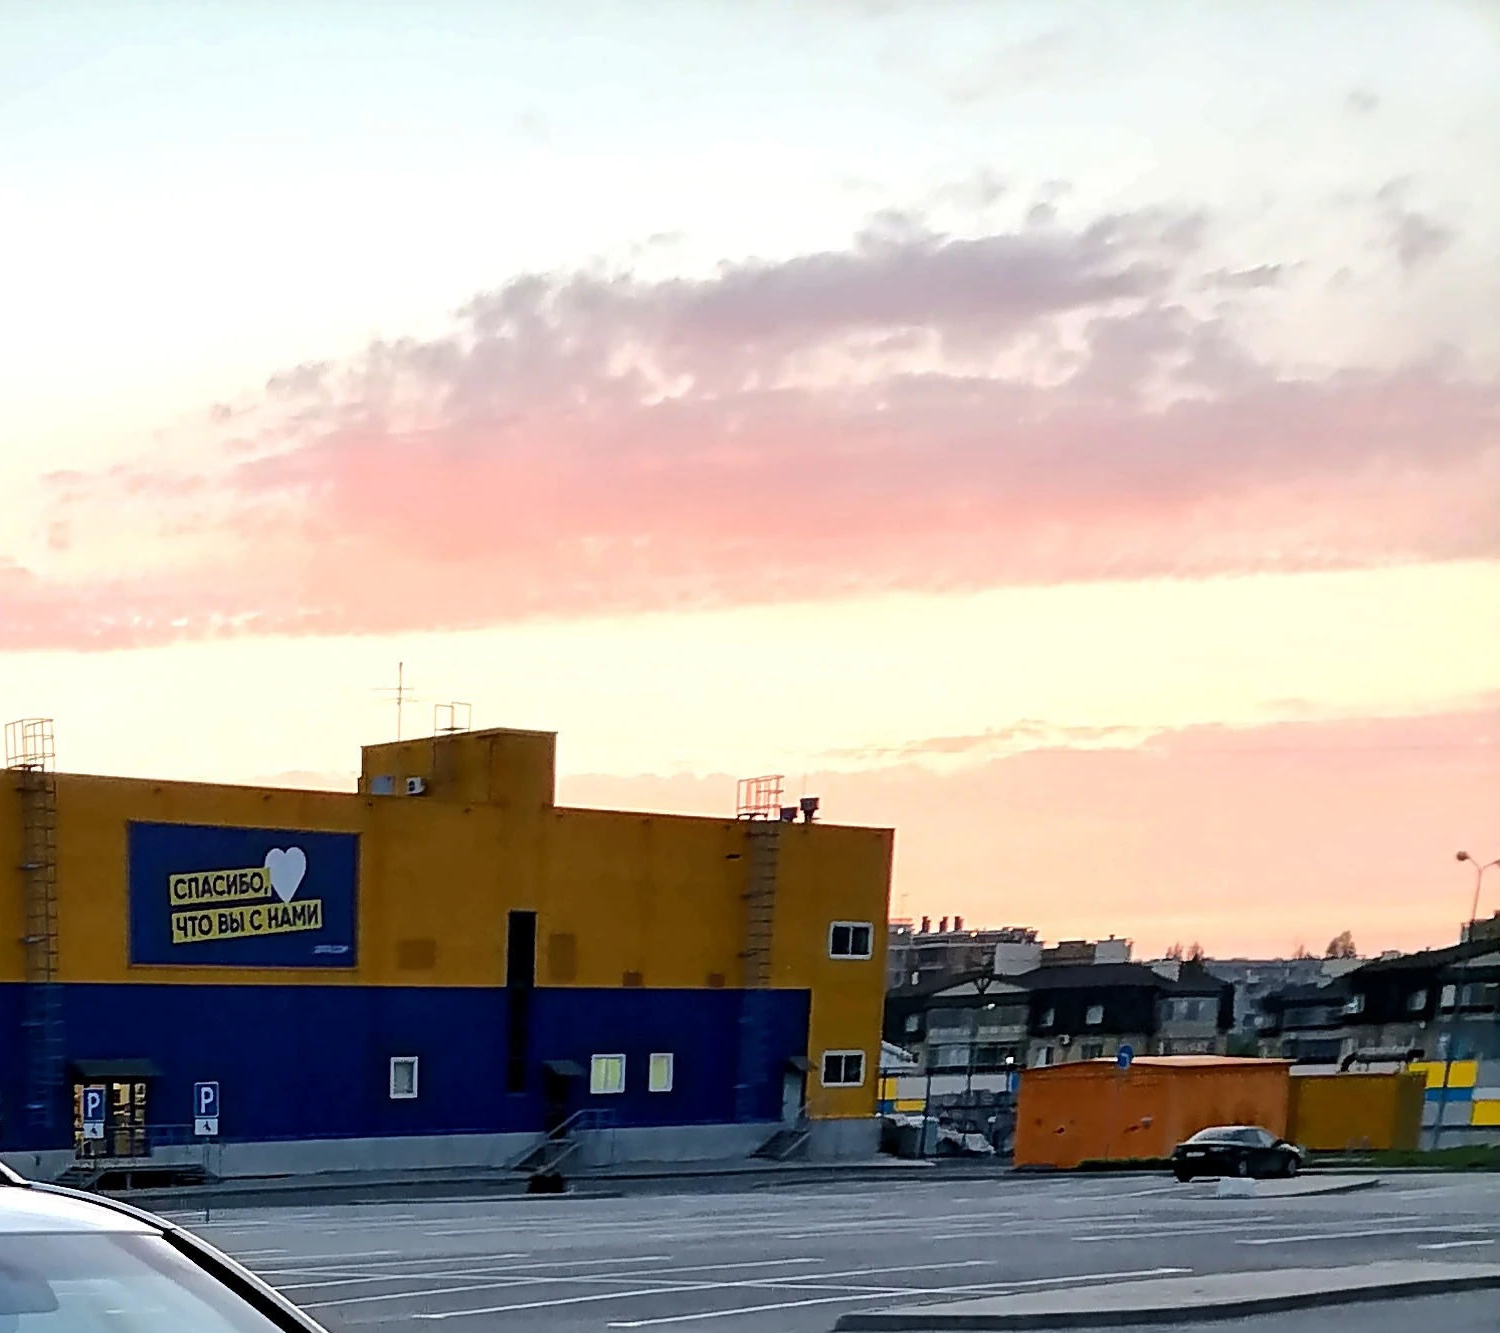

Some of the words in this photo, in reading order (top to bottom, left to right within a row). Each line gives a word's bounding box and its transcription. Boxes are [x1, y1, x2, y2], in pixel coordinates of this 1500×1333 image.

[173, 872, 269, 900] СПАСИБО,
[176, 914, 212, 939] ЧТО
[217, 912, 245, 933] ВЫ
[249, 909, 263, 931] С
[267, 905, 319, 930] НАМИ
[88, 1093, 100, 1118] P
[200, 1086, 214, 1113] P
